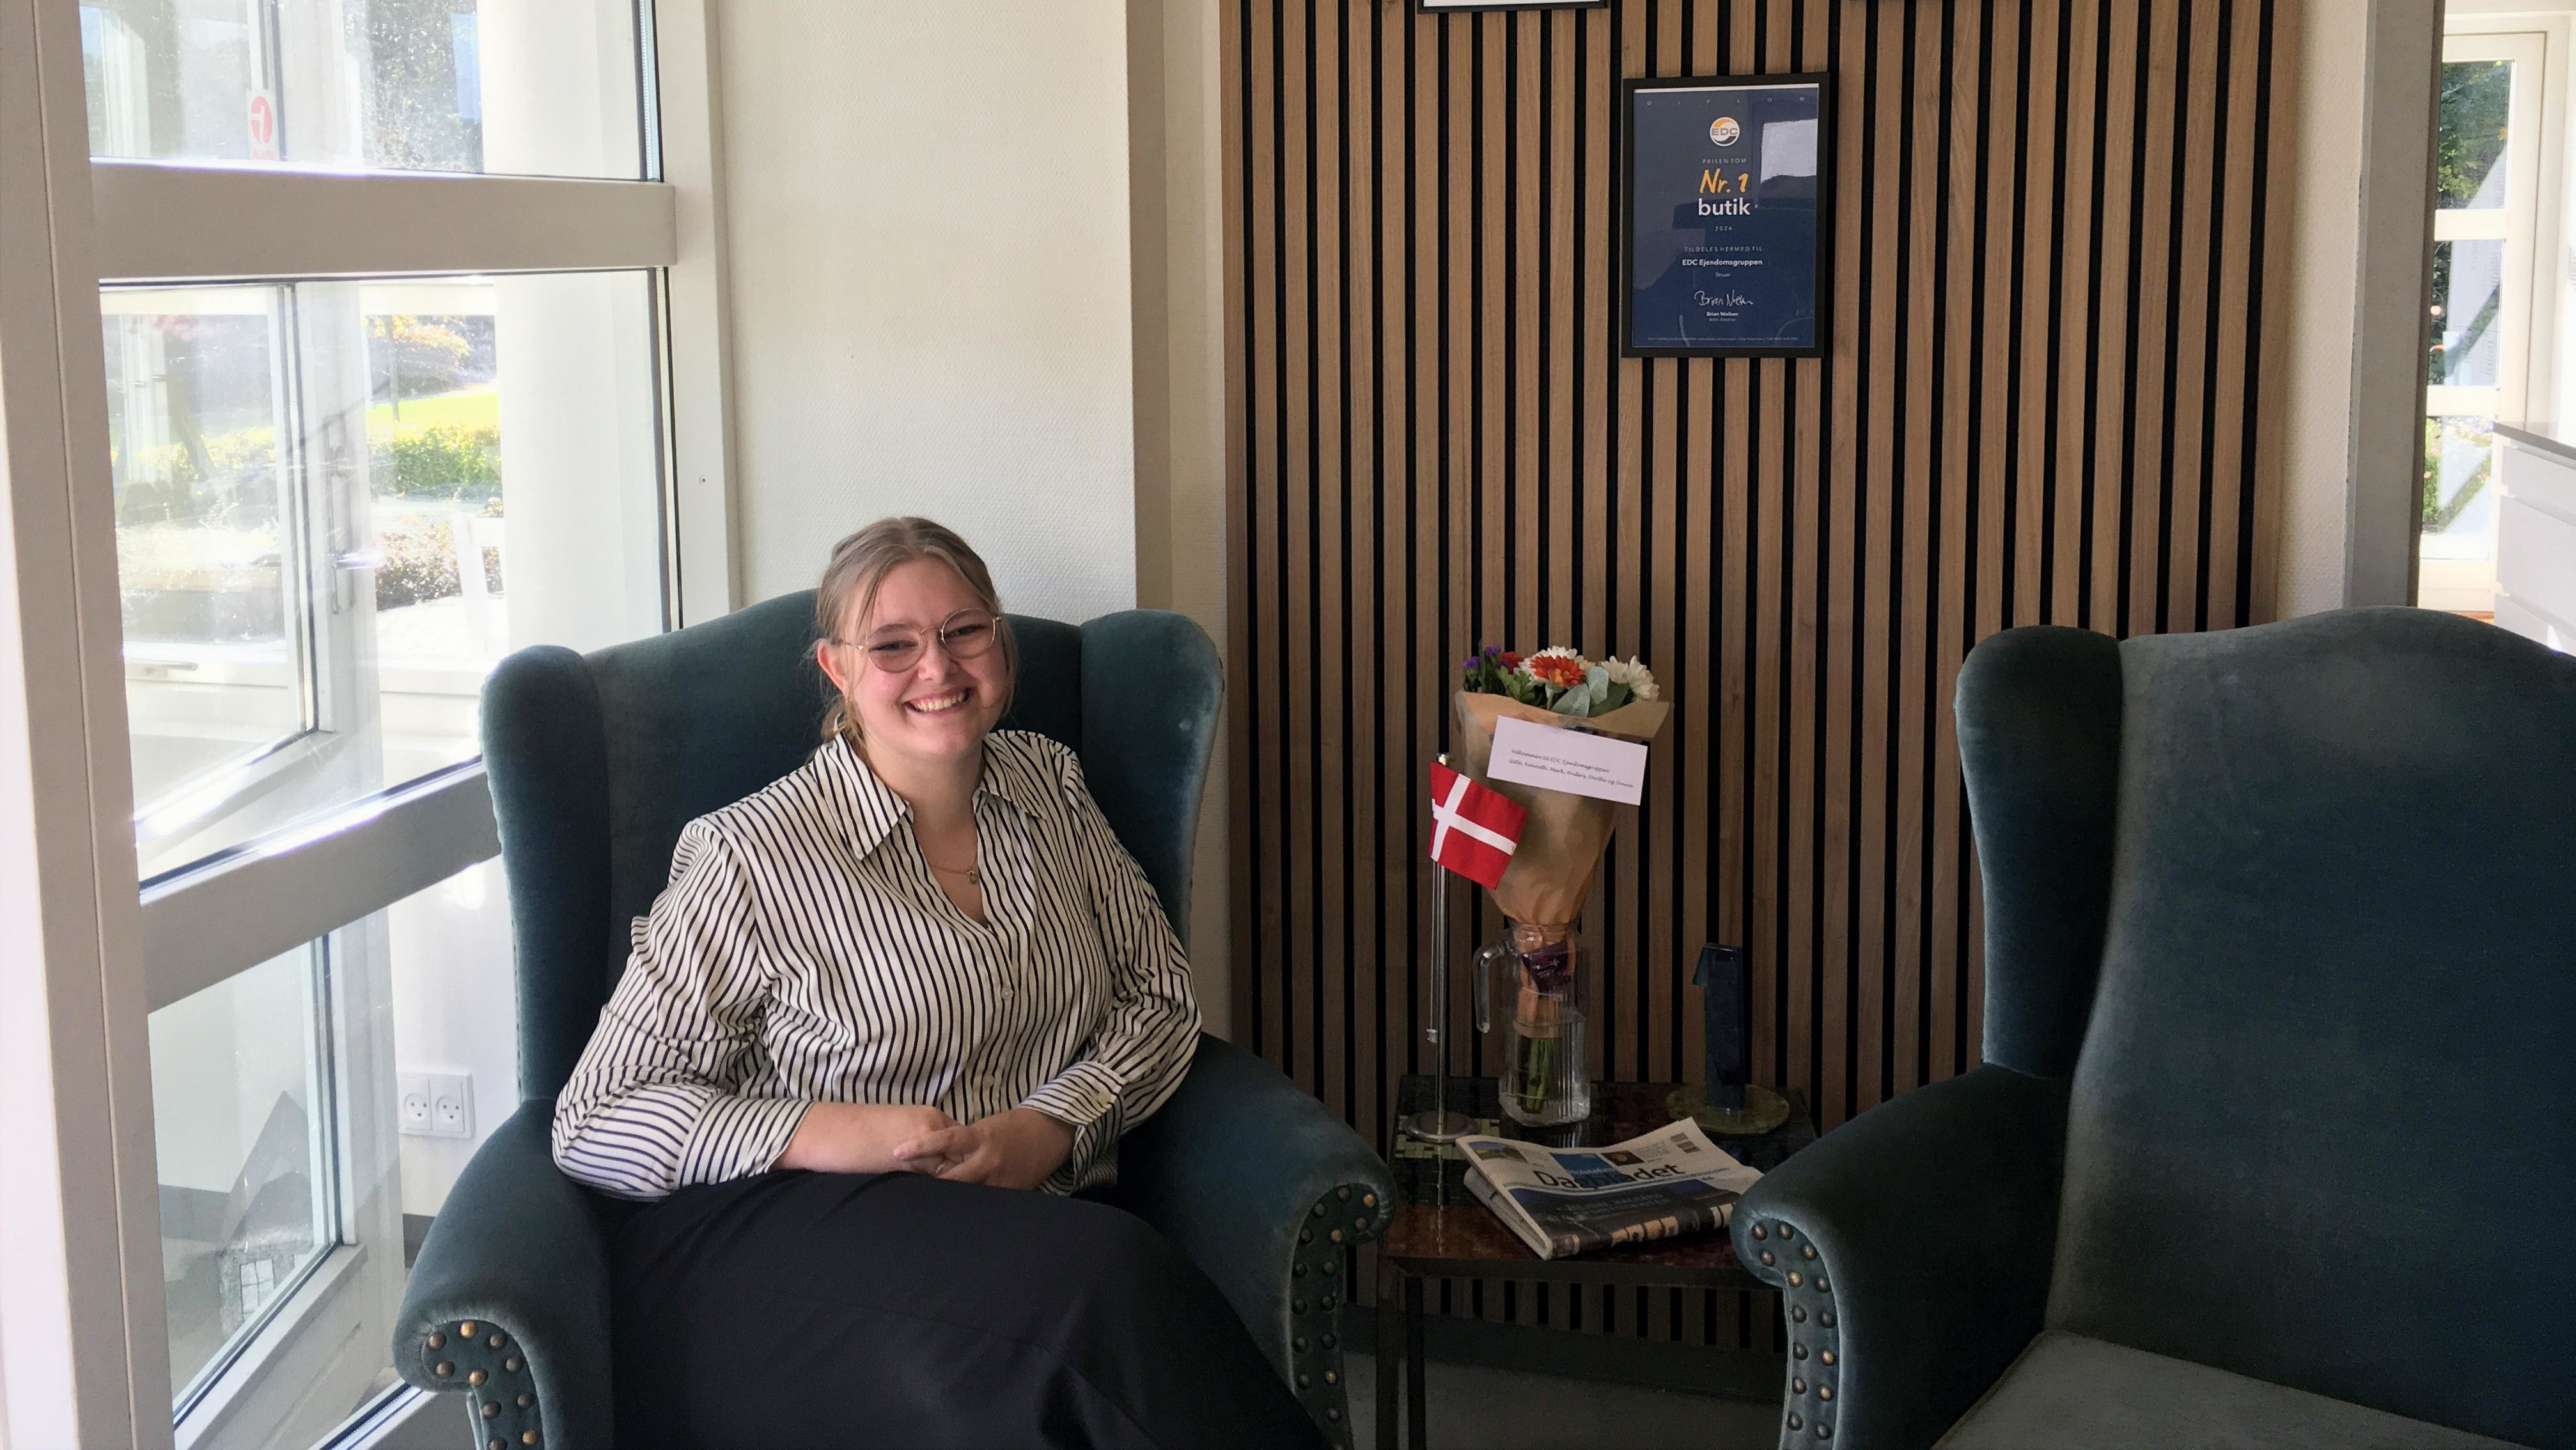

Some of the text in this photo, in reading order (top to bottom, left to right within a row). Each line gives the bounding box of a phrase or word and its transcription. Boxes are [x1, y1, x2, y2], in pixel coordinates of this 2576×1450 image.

[1711, 127, 1738, 136] EDC
[1699, 168, 1749, 194] Nr. 1
[1698, 198, 1751, 215] butik
[1699, 258, 1763, 267] Ejendomsgruppen
